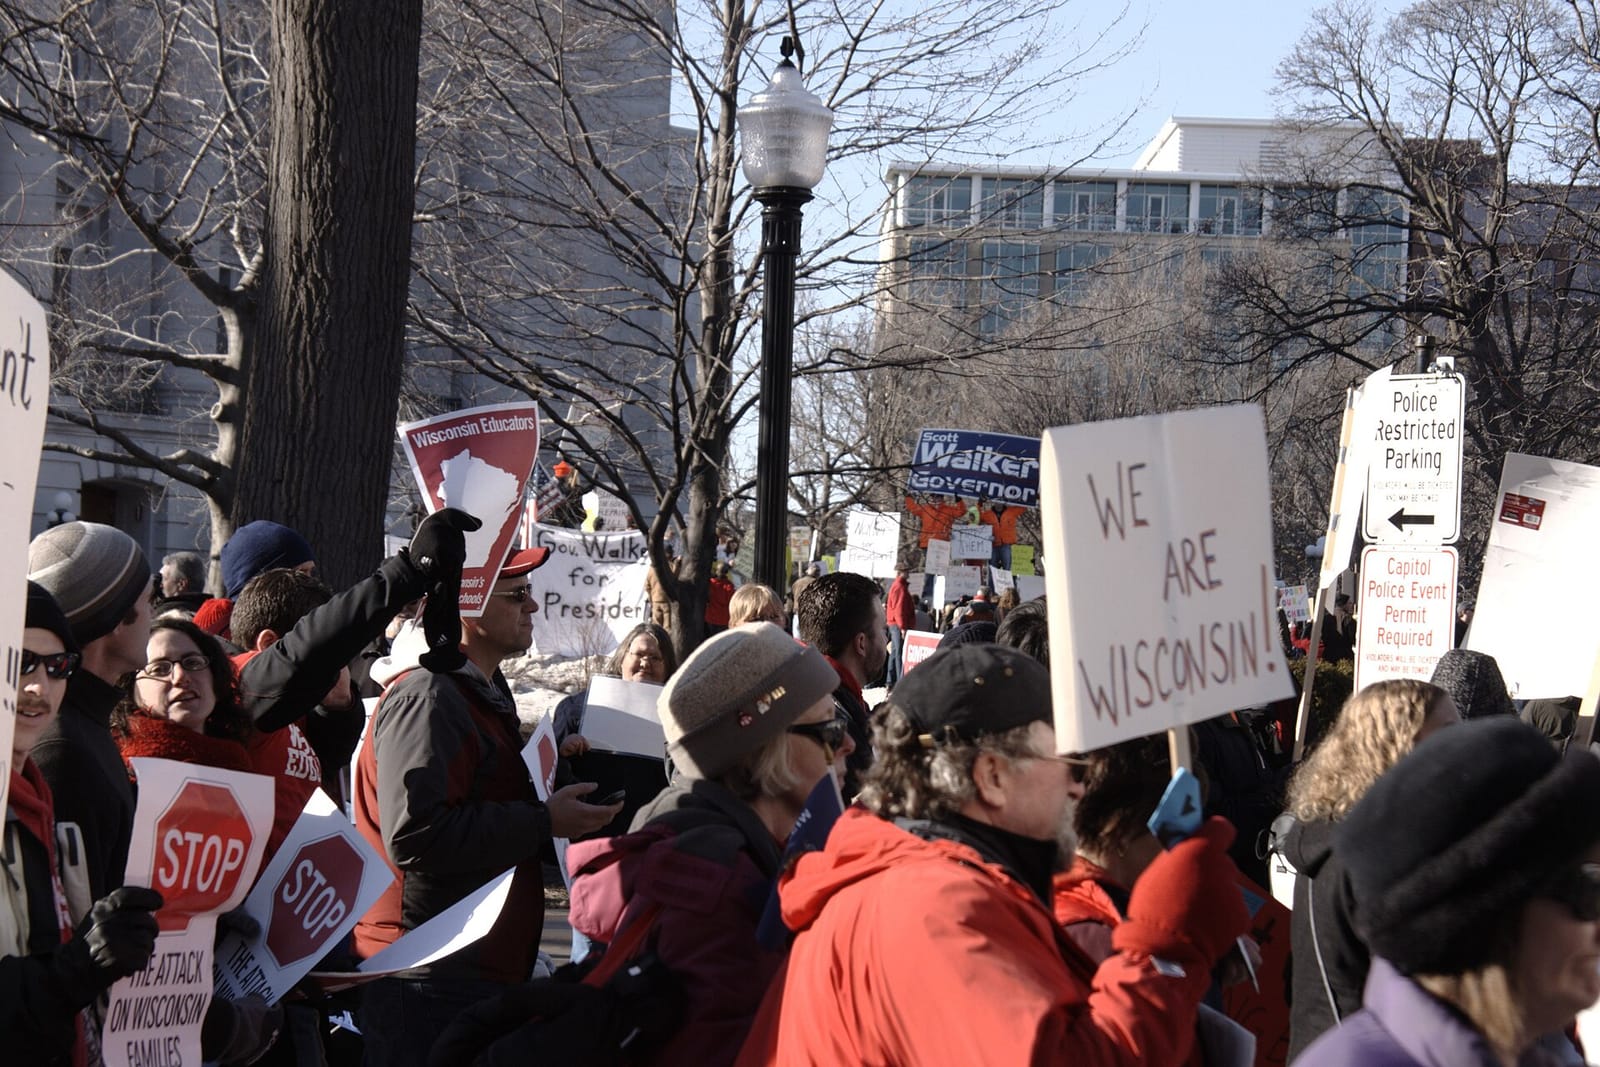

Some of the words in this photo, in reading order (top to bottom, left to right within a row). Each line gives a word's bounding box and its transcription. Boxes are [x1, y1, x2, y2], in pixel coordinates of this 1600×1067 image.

[0, 316, 35, 411] n't
[1393, 390, 1438, 413] Police
[412, 420, 480, 449] Wisconsin
[480, 415, 535, 434] Educators
[922, 432, 959, 443] Scott
[1375, 417, 1455, 441] Restricted
[920, 442, 1040, 479] Walker
[1385, 447, 1442, 476] Parking
[911, 470, 1036, 502] Governor
[1087, 461, 1150, 540] WE
[537, 529, 579, 557] Gov.
[581, 533, 648, 560] Walke
[568, 567, 609, 587] for
[1163, 528, 1223, 602] ARE
[1387, 557, 1431, 579] Capitol
[1368, 580, 1405, 599] Police
[1411, 580, 1447, 600] Event
[1385, 605, 1427, 624] Permit
[1078, 564, 1277, 727] WISCONSIN!
[1377, 627, 1433, 649] Required
[158, 828, 245, 893] STOP
[282, 858, 346, 940] STOP
[153, 950, 205, 987] ATTACK
[227, 941, 256, 980] THE
[110, 997, 132, 1034] ON
[131, 992, 208, 1031] WISCONSIN
[126, 1036, 182, 1067] FAMILIES
